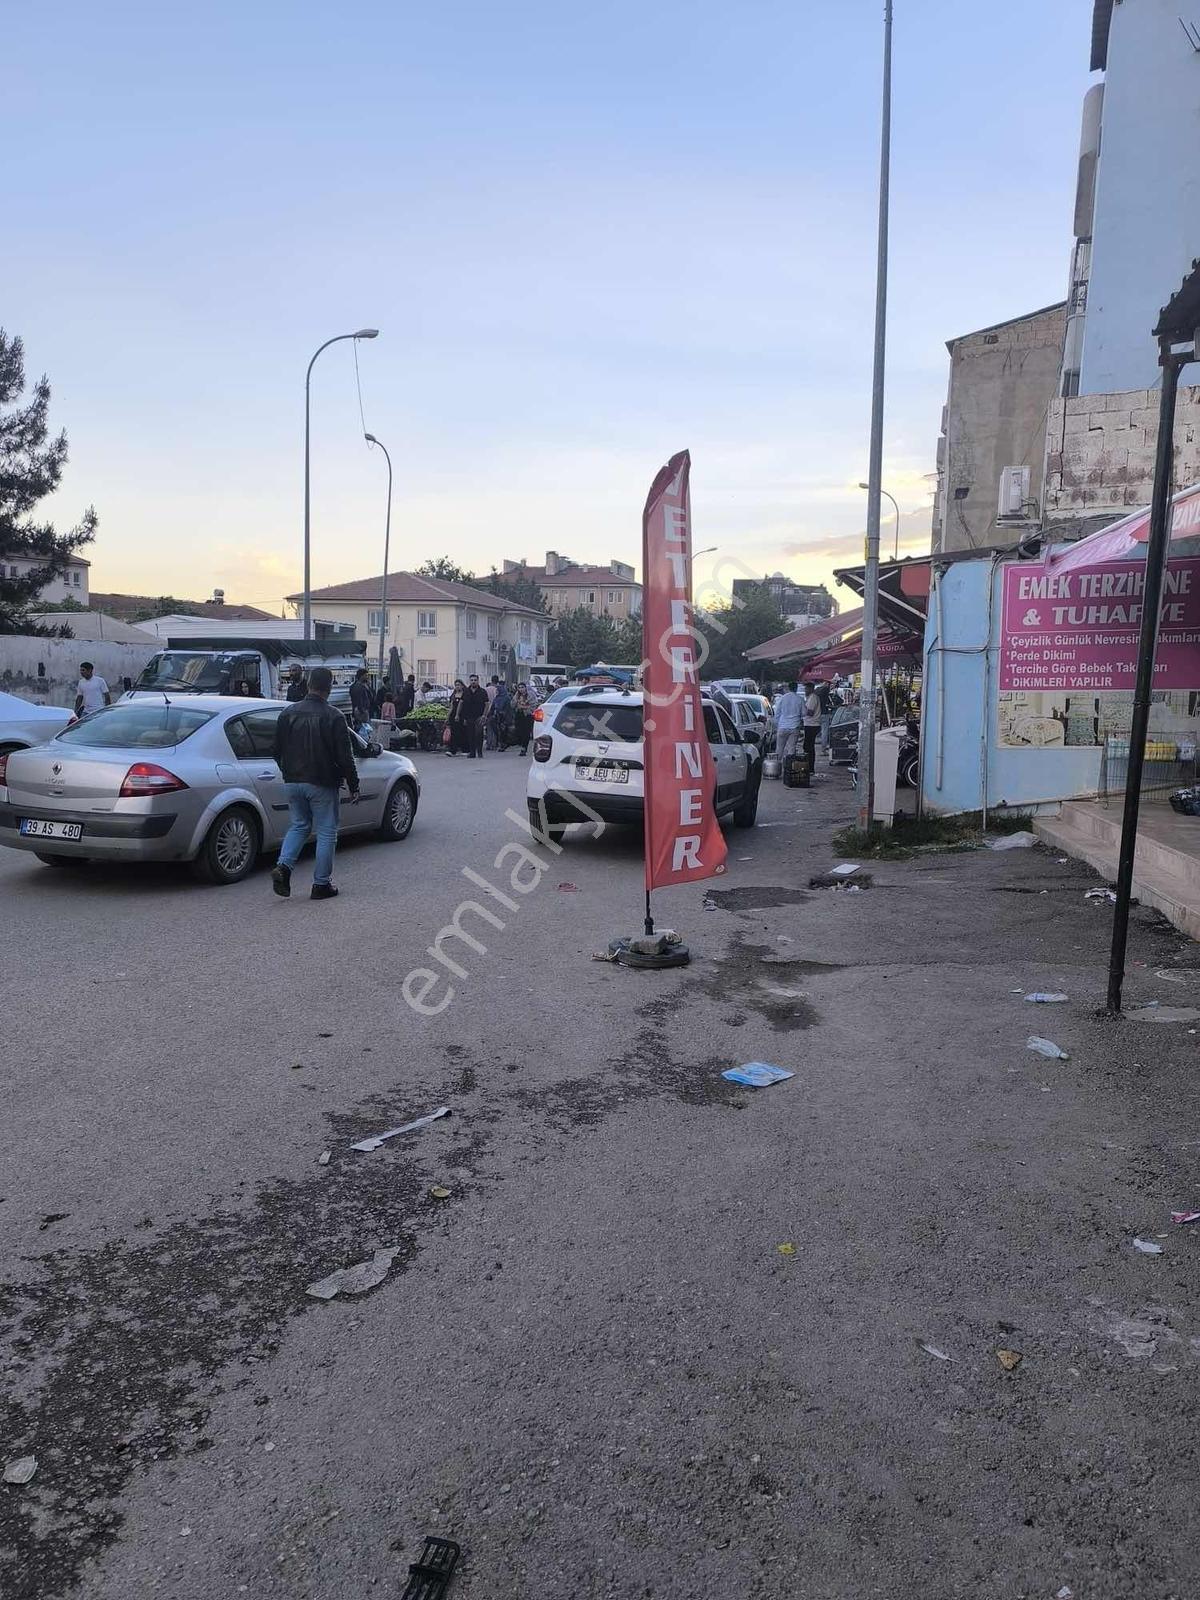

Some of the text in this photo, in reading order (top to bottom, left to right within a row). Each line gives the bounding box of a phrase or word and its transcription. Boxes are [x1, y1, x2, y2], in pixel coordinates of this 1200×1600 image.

[1019, 575, 1072, 600] EMEK
[1023, 603, 1185, 626] & TUHAFYE
[1011, 635, 1051, 649] Çeyizlik
[1055, 634, 1091, 645] Günlük
[1010, 649, 1076, 661] Perde Dikimi
[1010, 663, 1048, 674] Tercihe
[1052, 662, 1077, 674] Göre
[1080, 662, 1113, 673] Bebek
[1070, 676, 1112, 687] YAPILIR
[27, 821, 80, 838] 39 AS 480
